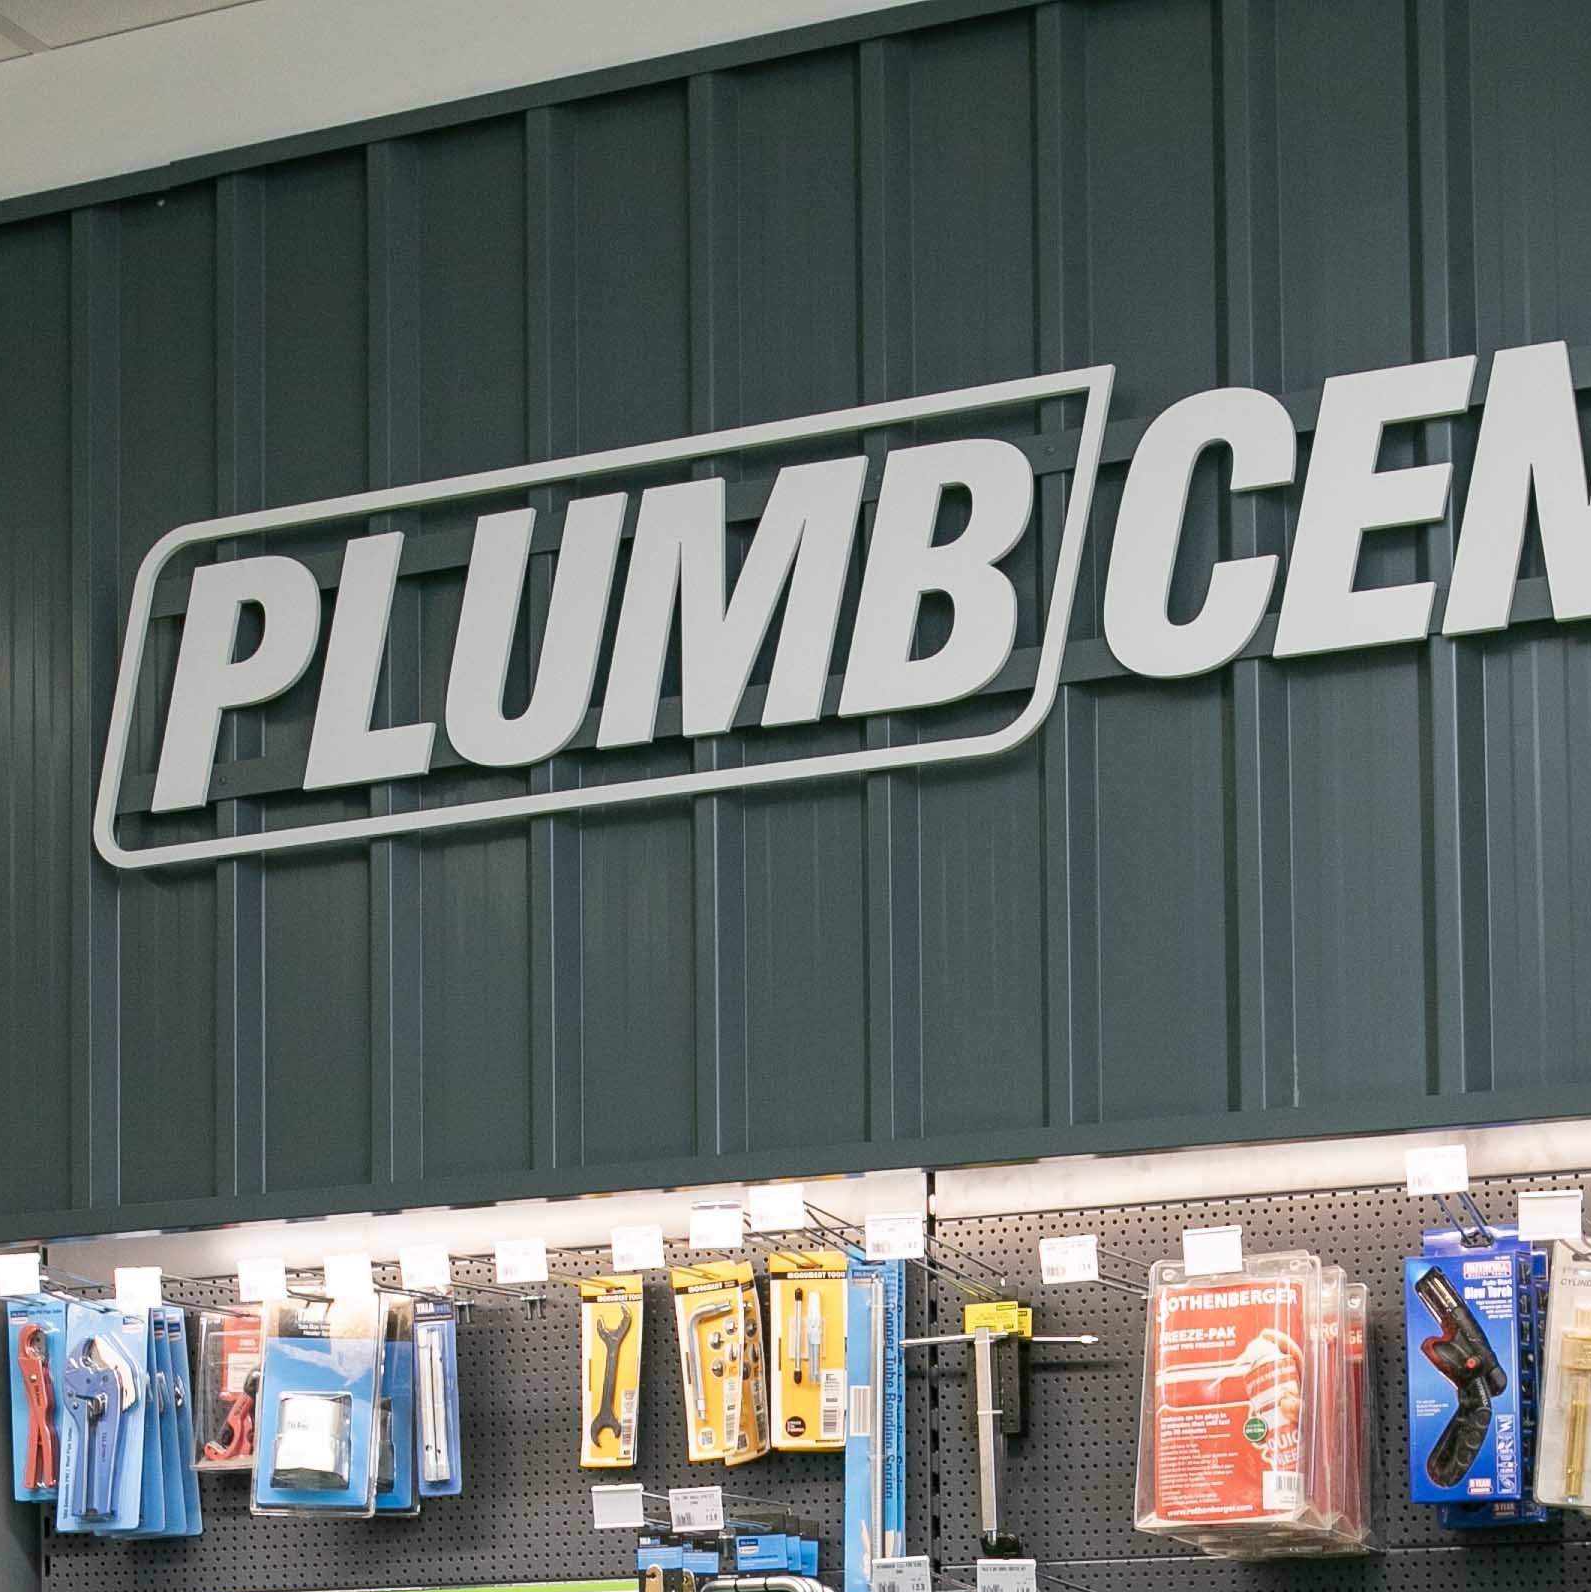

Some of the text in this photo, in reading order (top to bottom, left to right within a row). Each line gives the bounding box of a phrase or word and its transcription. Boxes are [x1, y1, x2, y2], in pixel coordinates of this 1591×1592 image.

[151, 437, 1032, 816] PLUMB
[1465, 1286, 1513, 1299] Blow Torch
[1168, 1504, 1252, 1517] www.rothenberger.com
